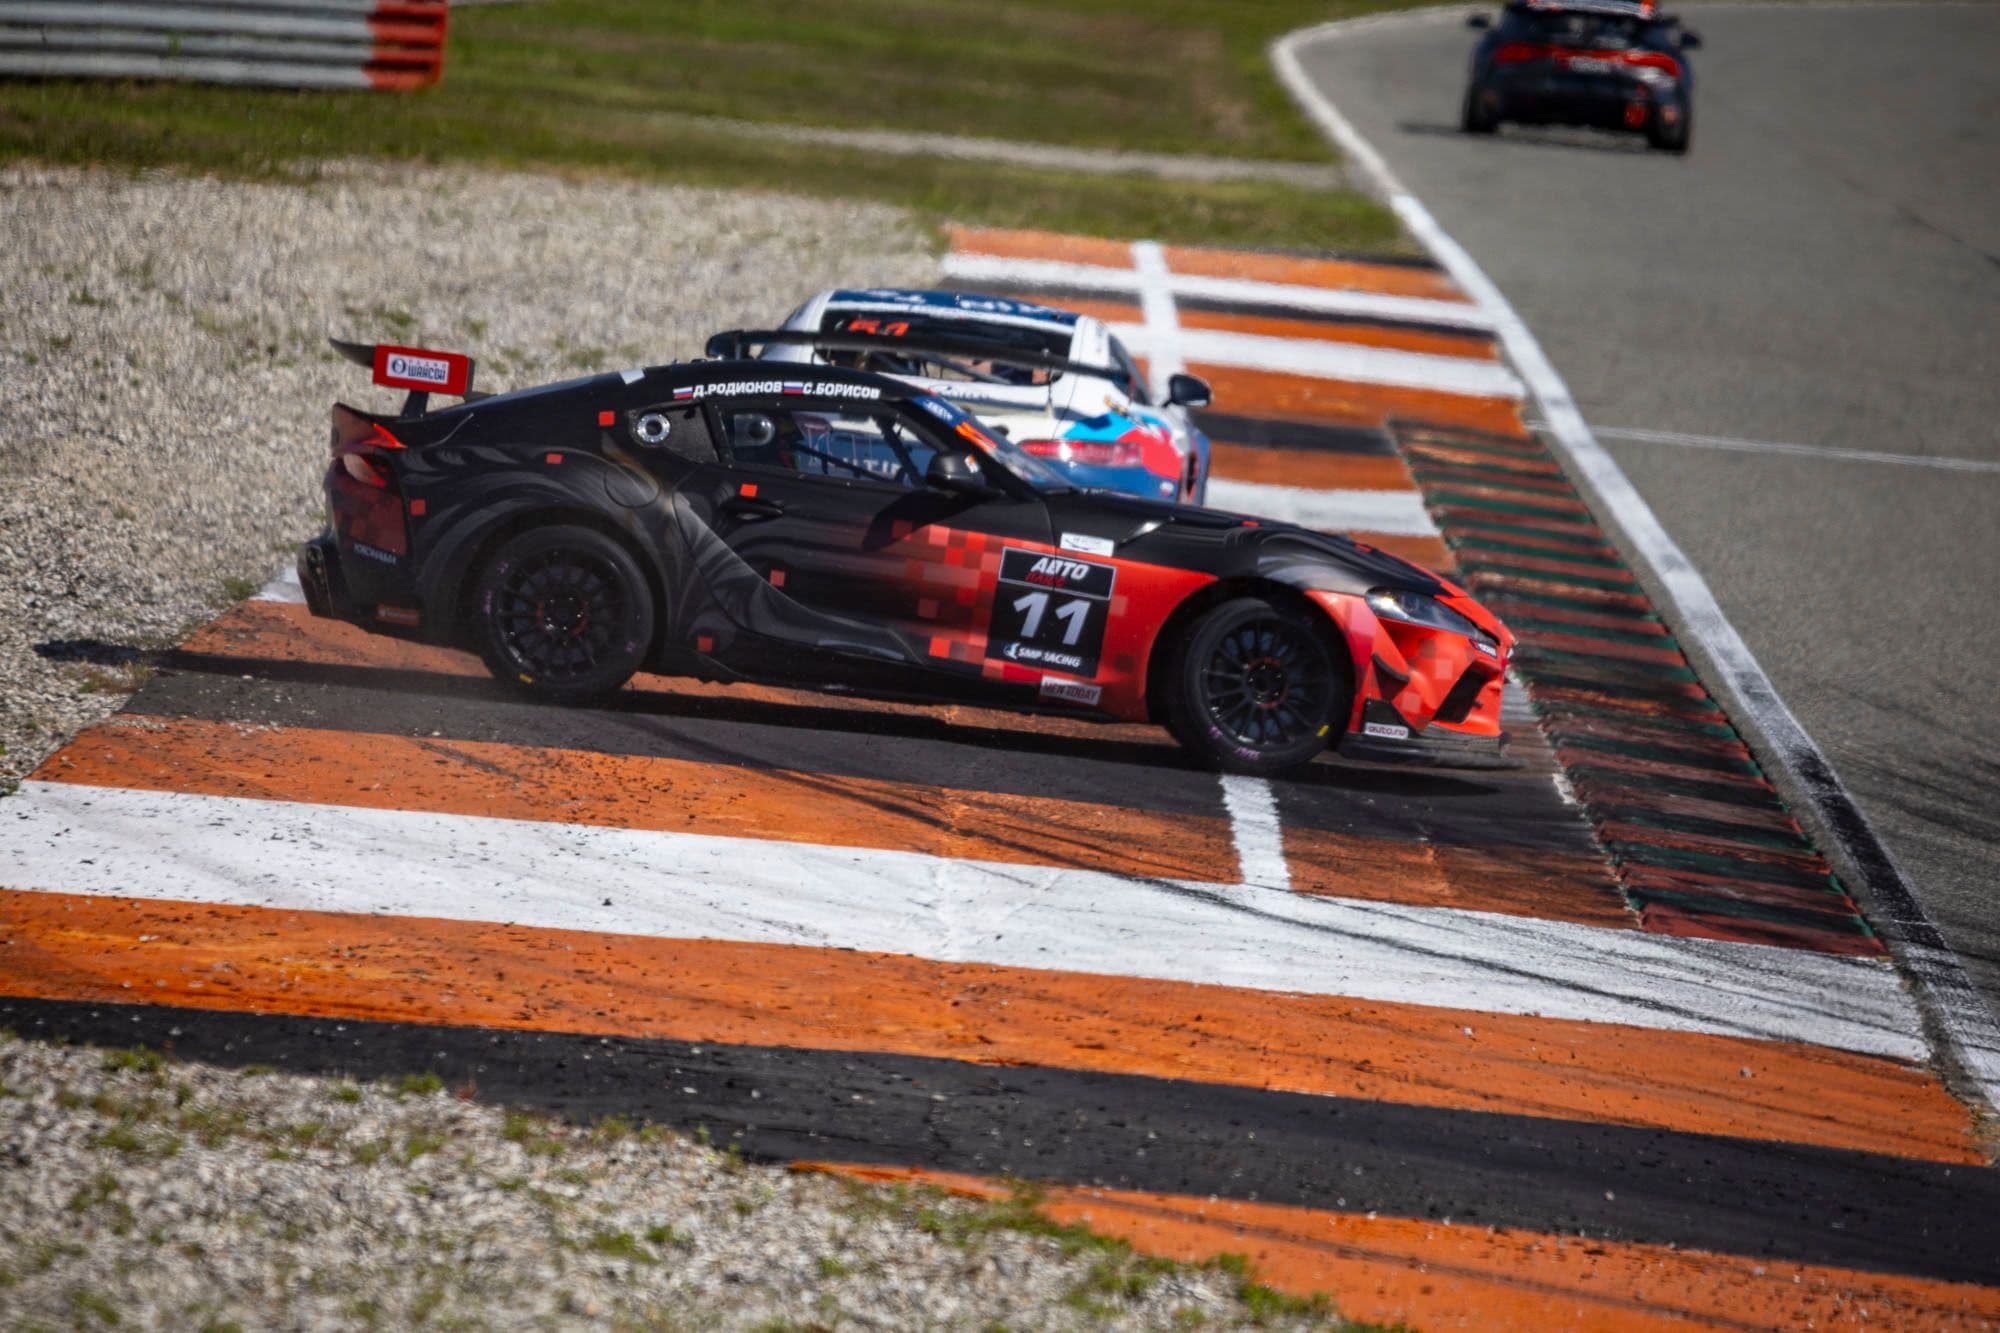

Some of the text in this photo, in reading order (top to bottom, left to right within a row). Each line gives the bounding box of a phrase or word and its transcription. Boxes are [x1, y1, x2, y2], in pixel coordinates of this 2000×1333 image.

[407, 365, 446, 381] ШАНСОН
[692, 381, 881, 399] Д.РОДИОНОВ С.БОРИСОВ
[1013, 592, 1091, 646] 11
[1018, 647, 1081, 668] SMP RACING
[1367, 725, 1406, 737] auto.ru
